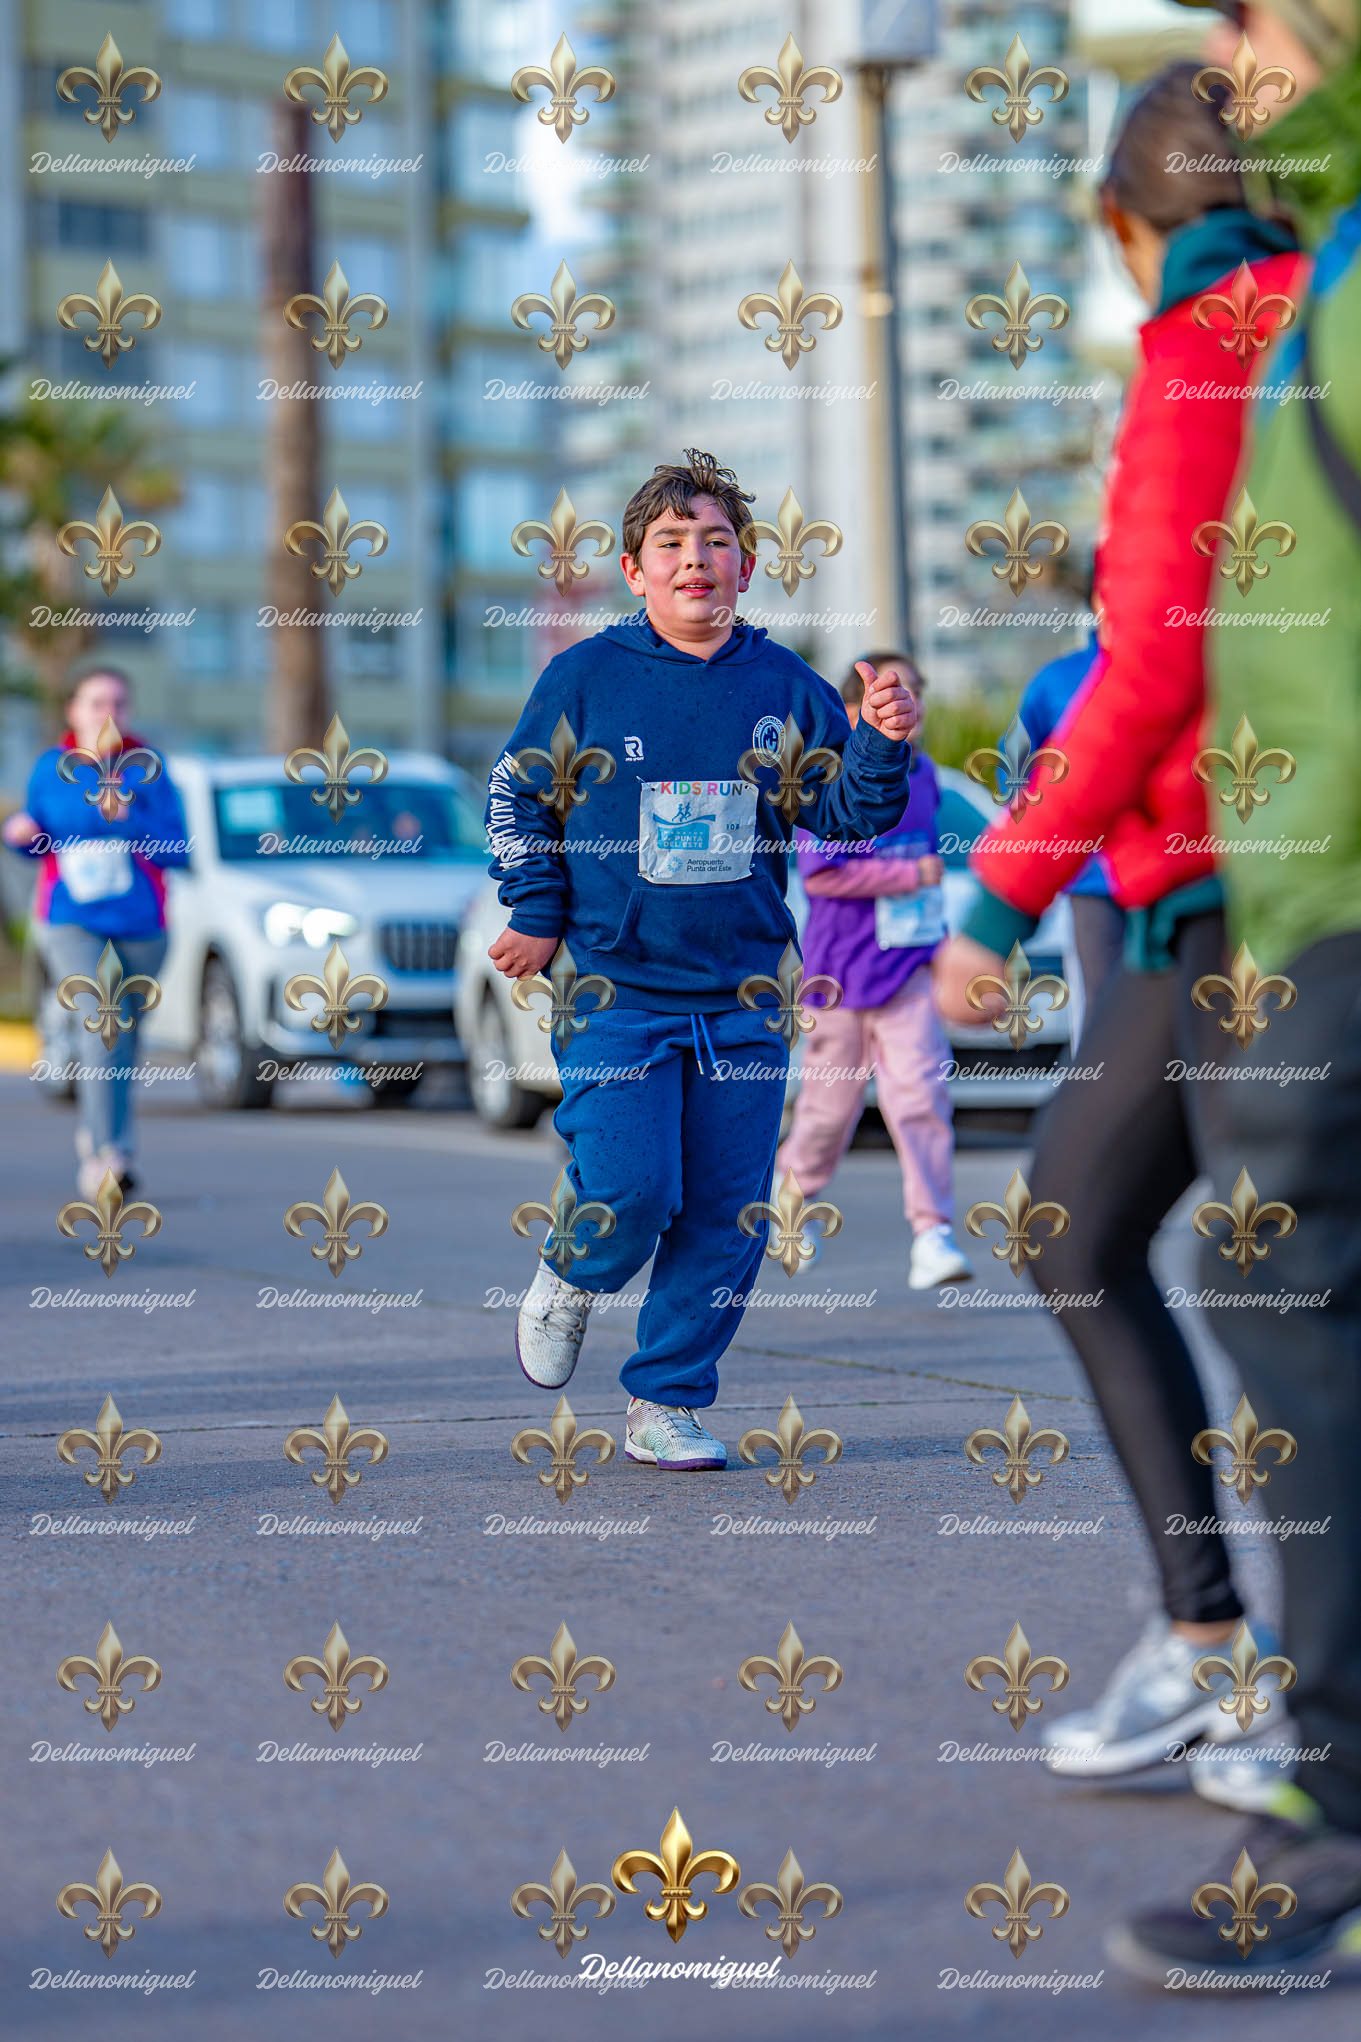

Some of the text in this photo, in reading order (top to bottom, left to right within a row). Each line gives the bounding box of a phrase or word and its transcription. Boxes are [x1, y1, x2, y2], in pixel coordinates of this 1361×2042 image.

[661, 781, 743, 796] KIDS RUN
[686, 858, 725, 866] Aeropuerto
